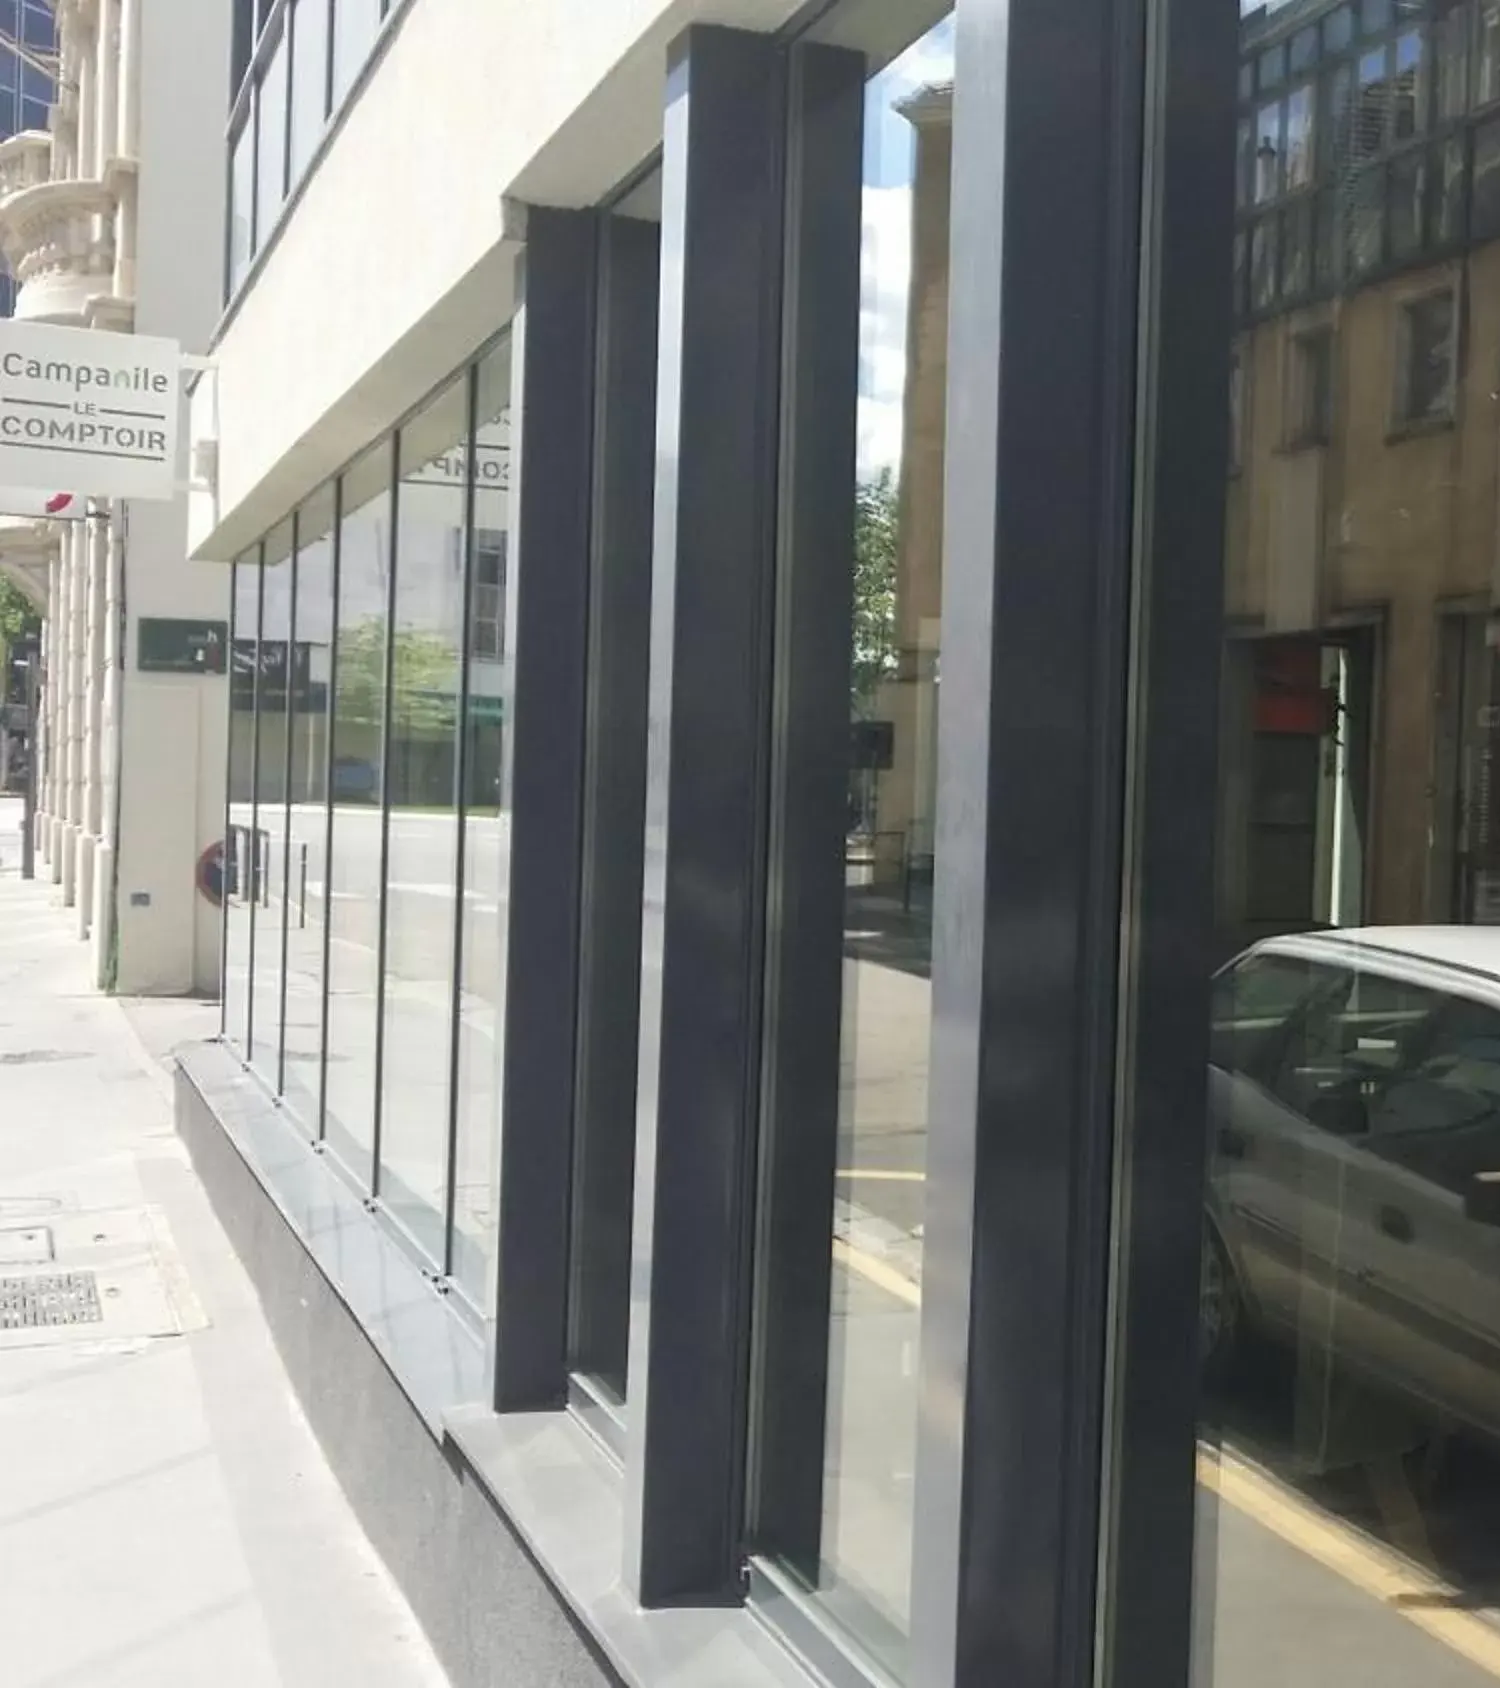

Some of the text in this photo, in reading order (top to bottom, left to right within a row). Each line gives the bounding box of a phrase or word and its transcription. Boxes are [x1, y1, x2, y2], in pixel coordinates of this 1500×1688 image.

[3, 353, 168, 392] Campanile
[73, 401, 97, 416] LE
[1, 415, 166, 451] COMPTOIR
